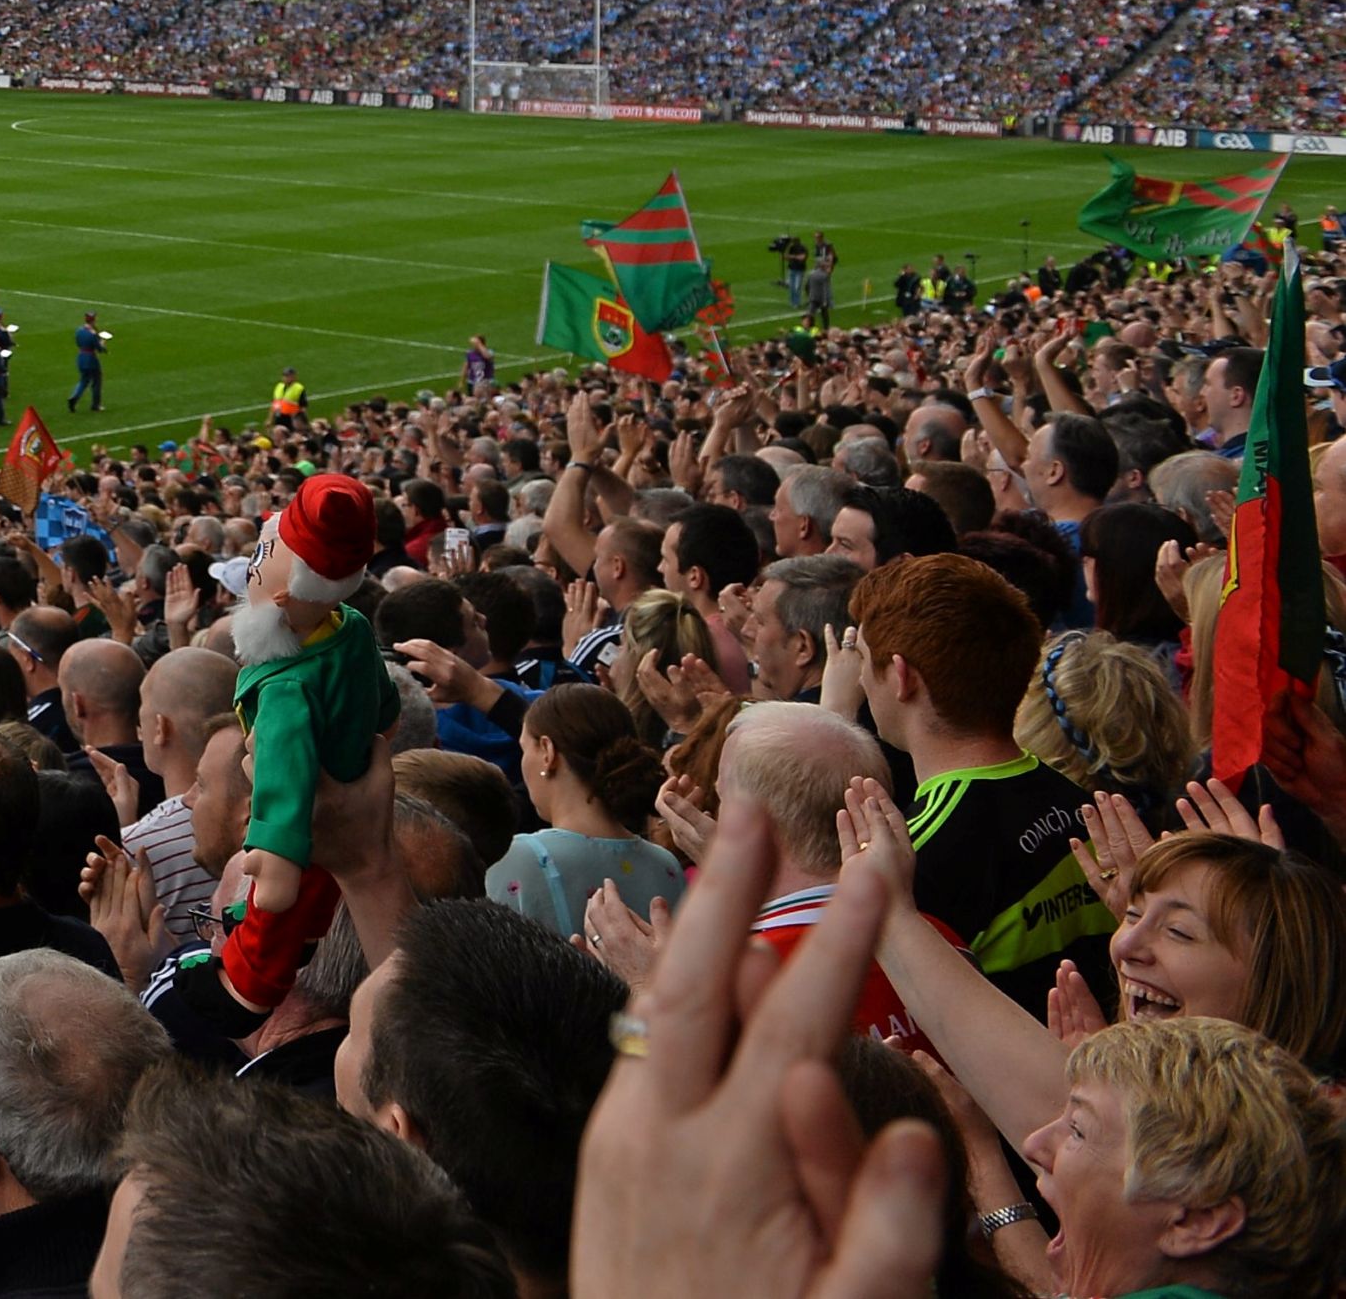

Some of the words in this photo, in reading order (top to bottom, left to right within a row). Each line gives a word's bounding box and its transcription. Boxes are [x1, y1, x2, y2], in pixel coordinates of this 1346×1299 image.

[264, 88, 286, 102] AIB
[311, 90, 334, 104] AIB
[360, 93, 383, 107] AIB
[410, 95, 434, 110] AIB
[656, 107, 701, 120] eircom
[746, 110, 803, 128] SuperValu
[808, 114, 866, 131] SuperValu
[937, 119, 998, 136] SuperValu
[1081, 127, 1114, 145] AIB
[1153, 129, 1187, 148] AIB
[1213, 133, 1255, 150] GAA
